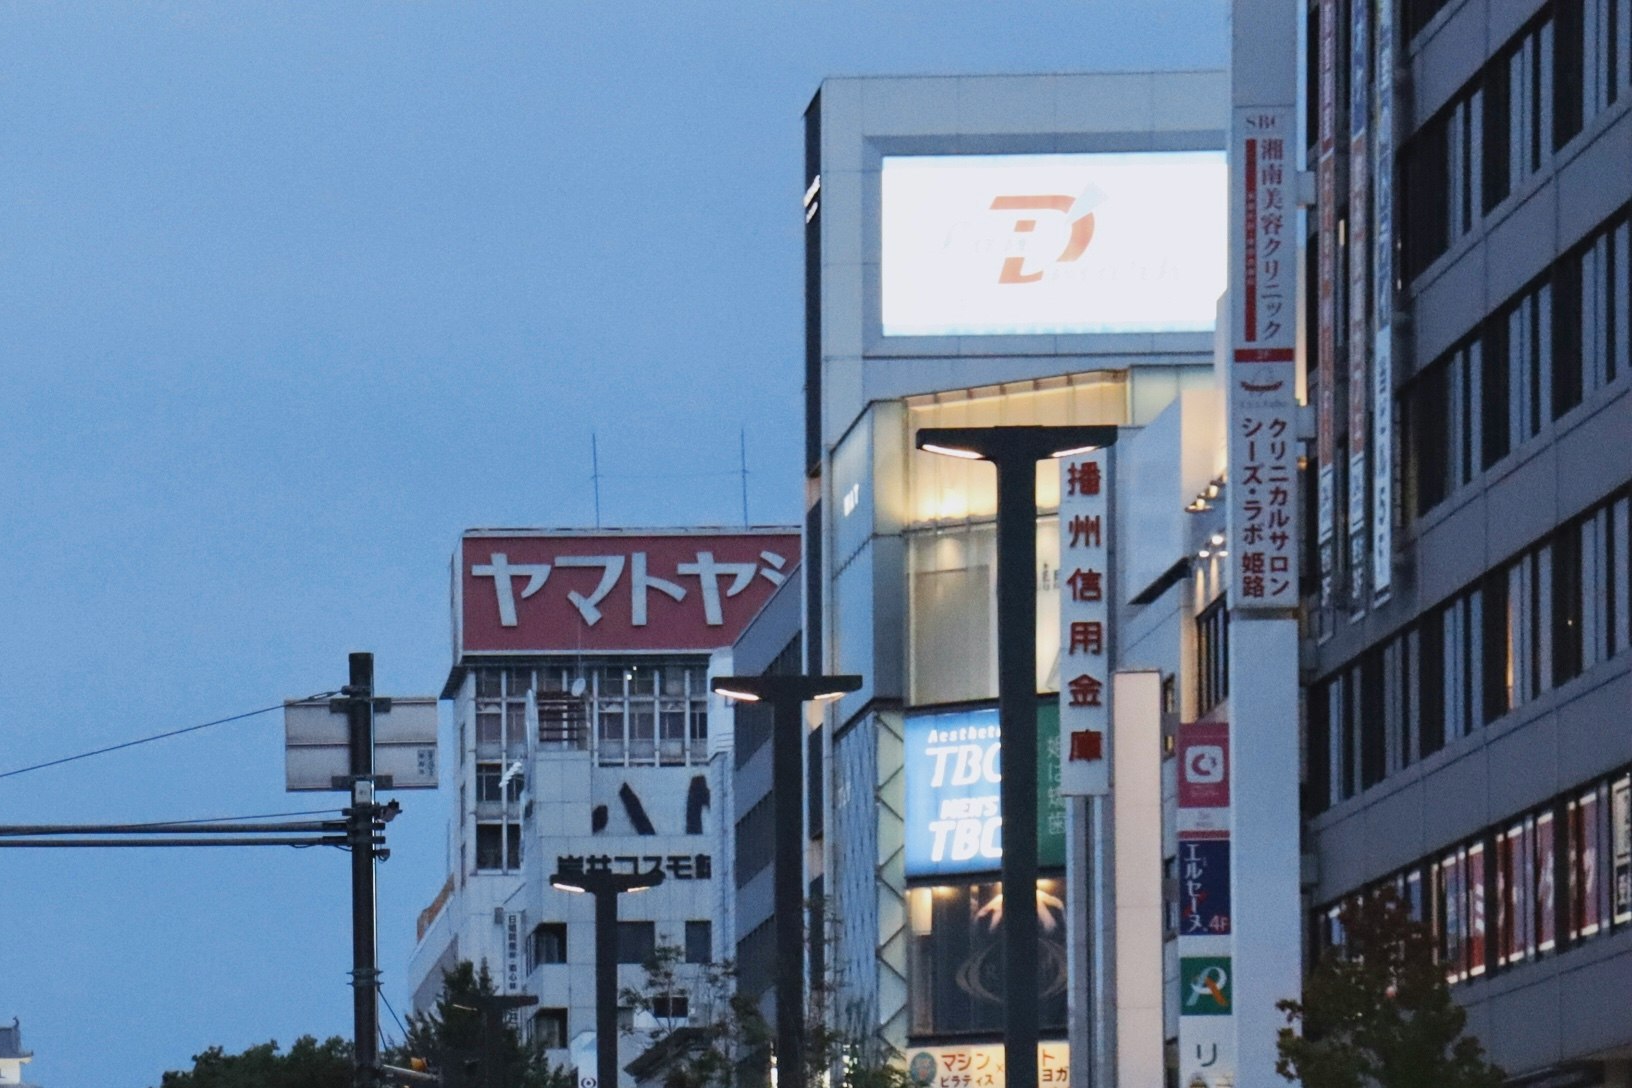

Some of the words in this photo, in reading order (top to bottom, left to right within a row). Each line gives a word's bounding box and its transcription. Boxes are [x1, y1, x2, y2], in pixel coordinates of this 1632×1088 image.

[1246, 115, 1277, 129] SBC
[1261, 139, 1284, 341] 湘南美容クリニック
[1268, 418, 1290, 597] クリニカルサロン
[1241, 551, 1266, 599] 姫路
[1067, 461, 1102, 762] 播州信用金庫
[925, 742, 1002, 788] TBC
[928, 816, 1003, 863] TBC
[941, 1053, 990, 1072] マシン
[941, 1074, 995, 1088] ピラティス
